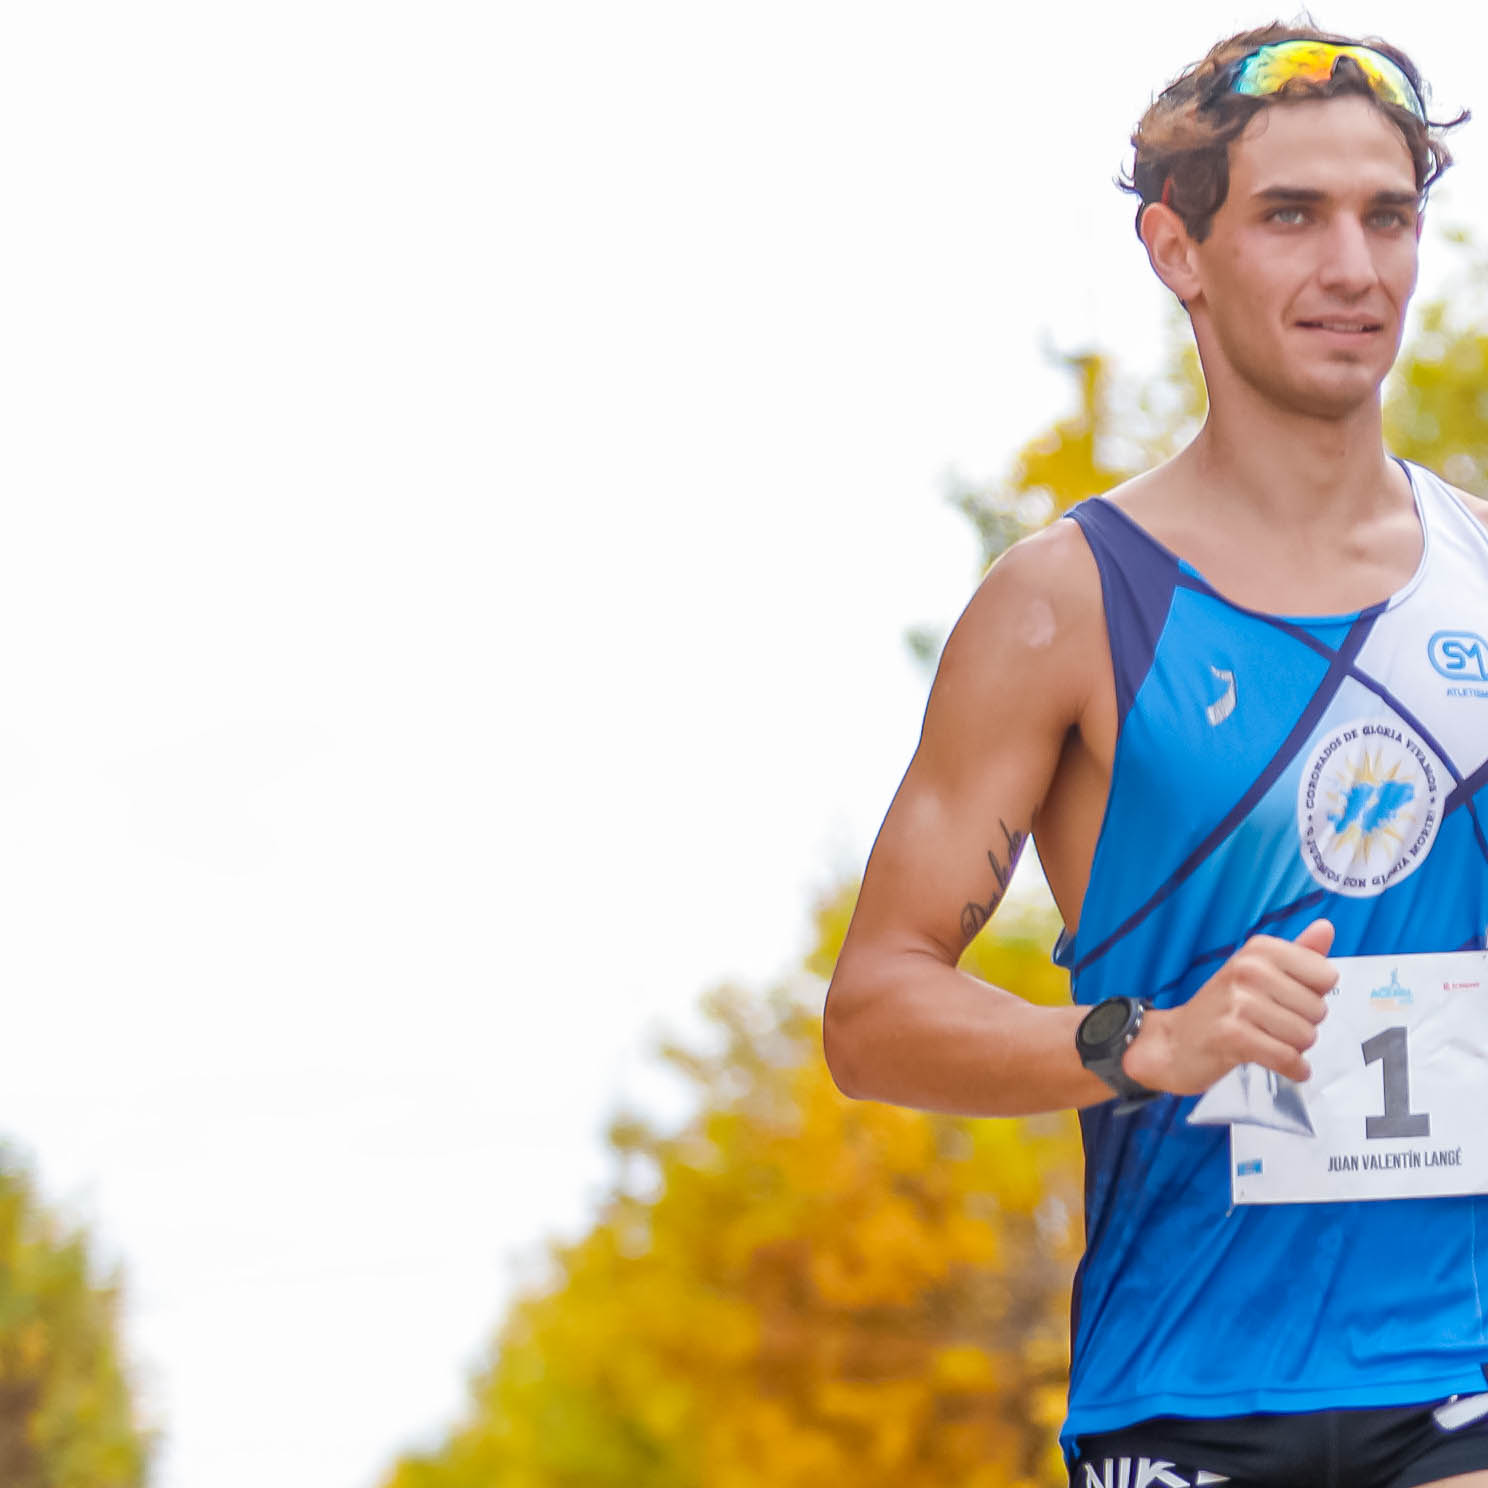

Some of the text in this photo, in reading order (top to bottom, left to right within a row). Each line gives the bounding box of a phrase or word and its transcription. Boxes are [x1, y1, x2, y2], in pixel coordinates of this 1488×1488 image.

[1343, 729, 1359, 743] DE
[1361, 1026, 1431, 1139] 1
[1328, 1146, 1462, 1172] JUAN VALENTÍN LANGÉ
